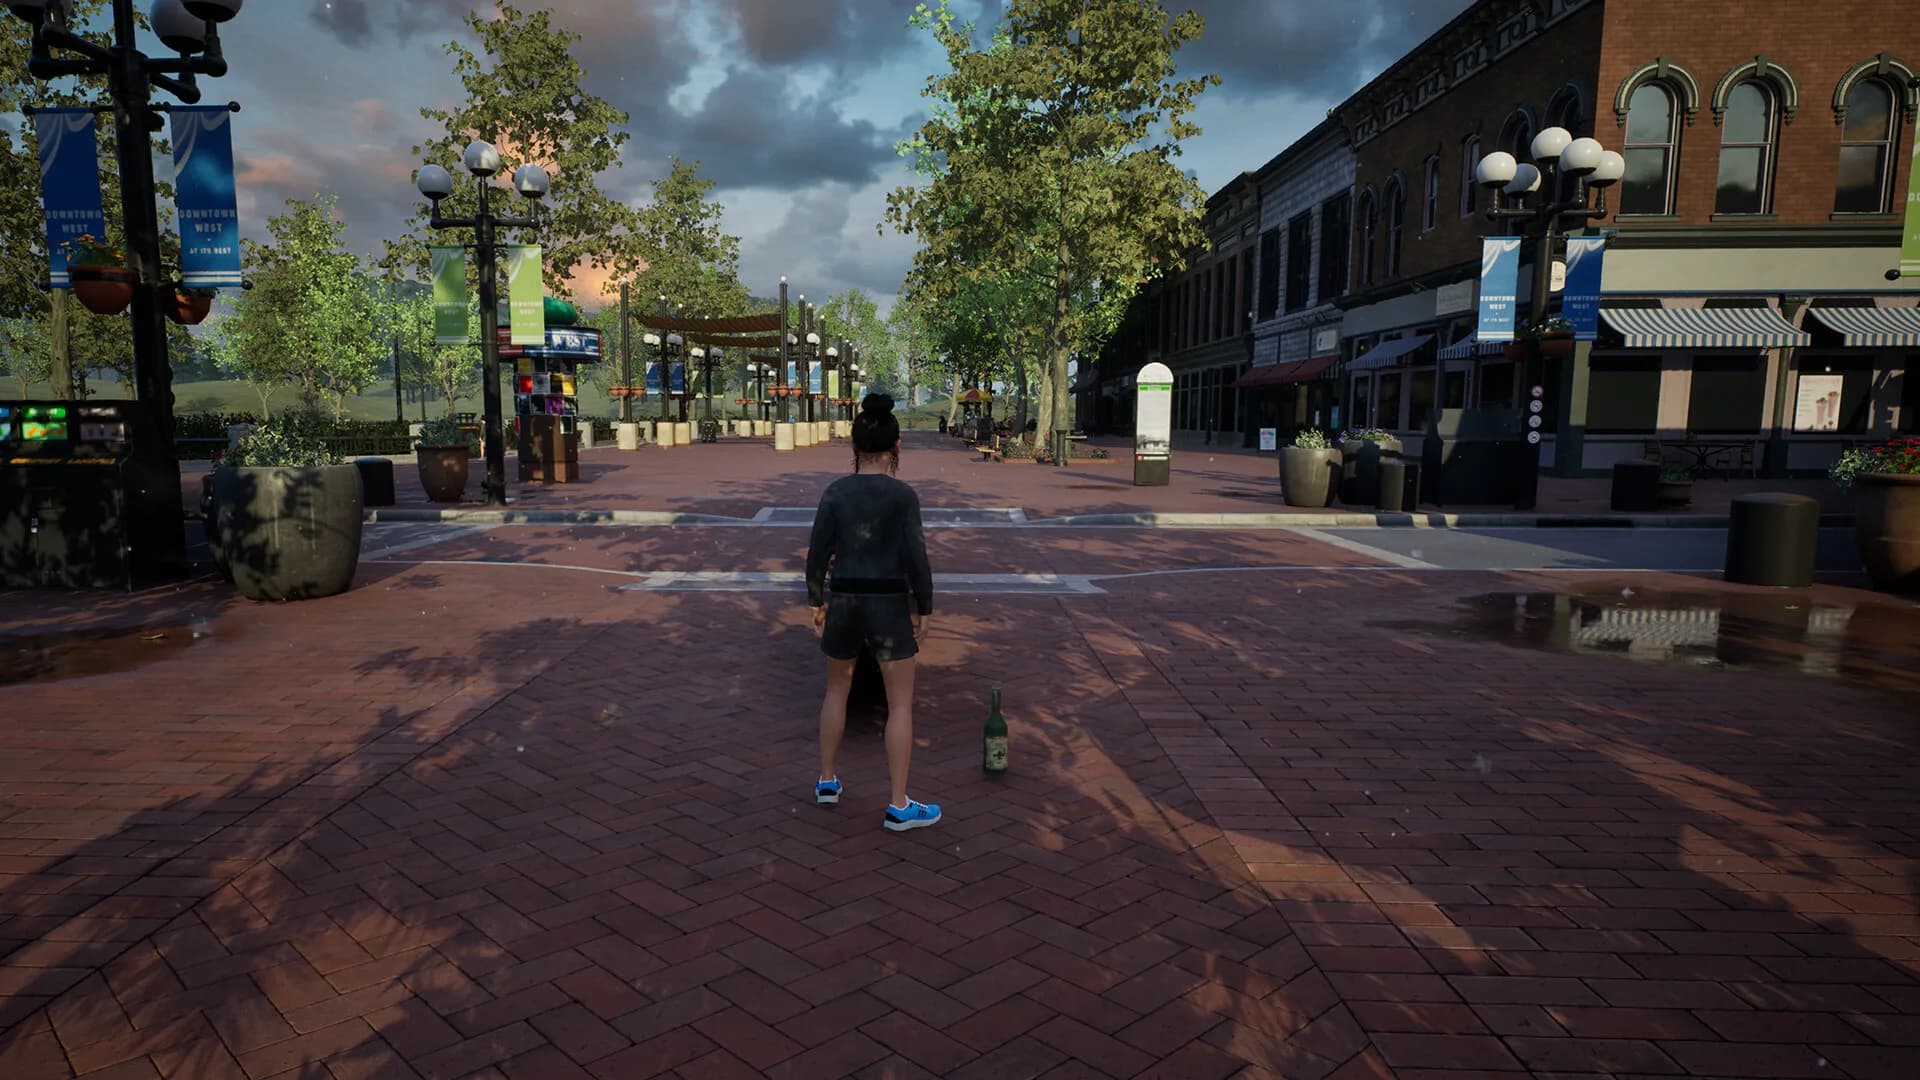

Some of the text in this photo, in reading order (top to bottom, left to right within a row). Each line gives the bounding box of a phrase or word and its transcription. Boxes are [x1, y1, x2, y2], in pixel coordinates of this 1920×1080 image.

[45, 210, 102, 219] DOWNTOWN
[179, 208, 236, 219] DOWNTOWN
[61, 223, 89, 233] WEST
[194, 223, 222, 233] WEST
